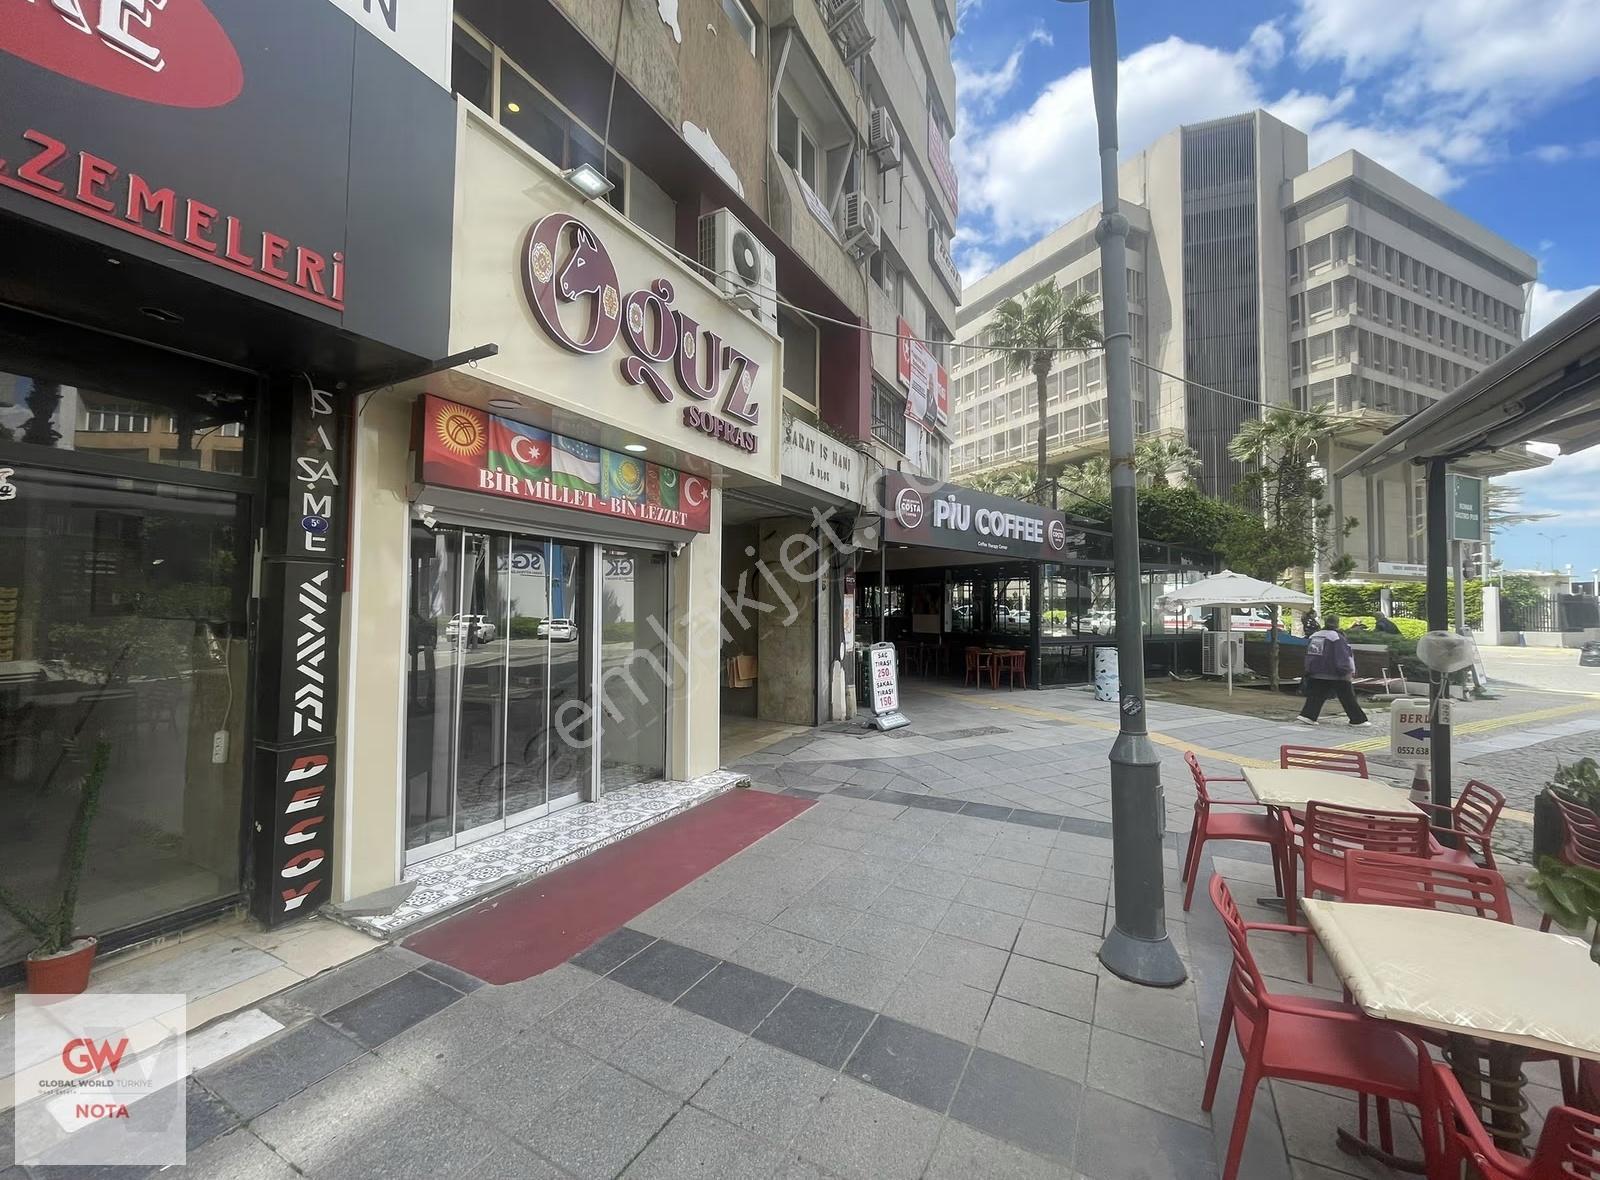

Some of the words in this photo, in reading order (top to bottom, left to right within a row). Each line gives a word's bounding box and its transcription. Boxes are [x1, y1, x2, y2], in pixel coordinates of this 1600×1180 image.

[682, 405, 758, 454] SOFRASI
[479, 466, 519, 494] BİR
[524, 477, 597, 508] MİLLET
[611, 496, 637, 514] BİN
[641, 503, 687, 526] LEZZET
[901, 502, 921, 513] COSTA
[975, 508, 1044, 543] COFFEE
[878, 667, 890, 678] 250
[880, 696, 892, 707] 150
[1397, 746, 1415, 755] 0552
[1416, 747, 1430, 755] 638
